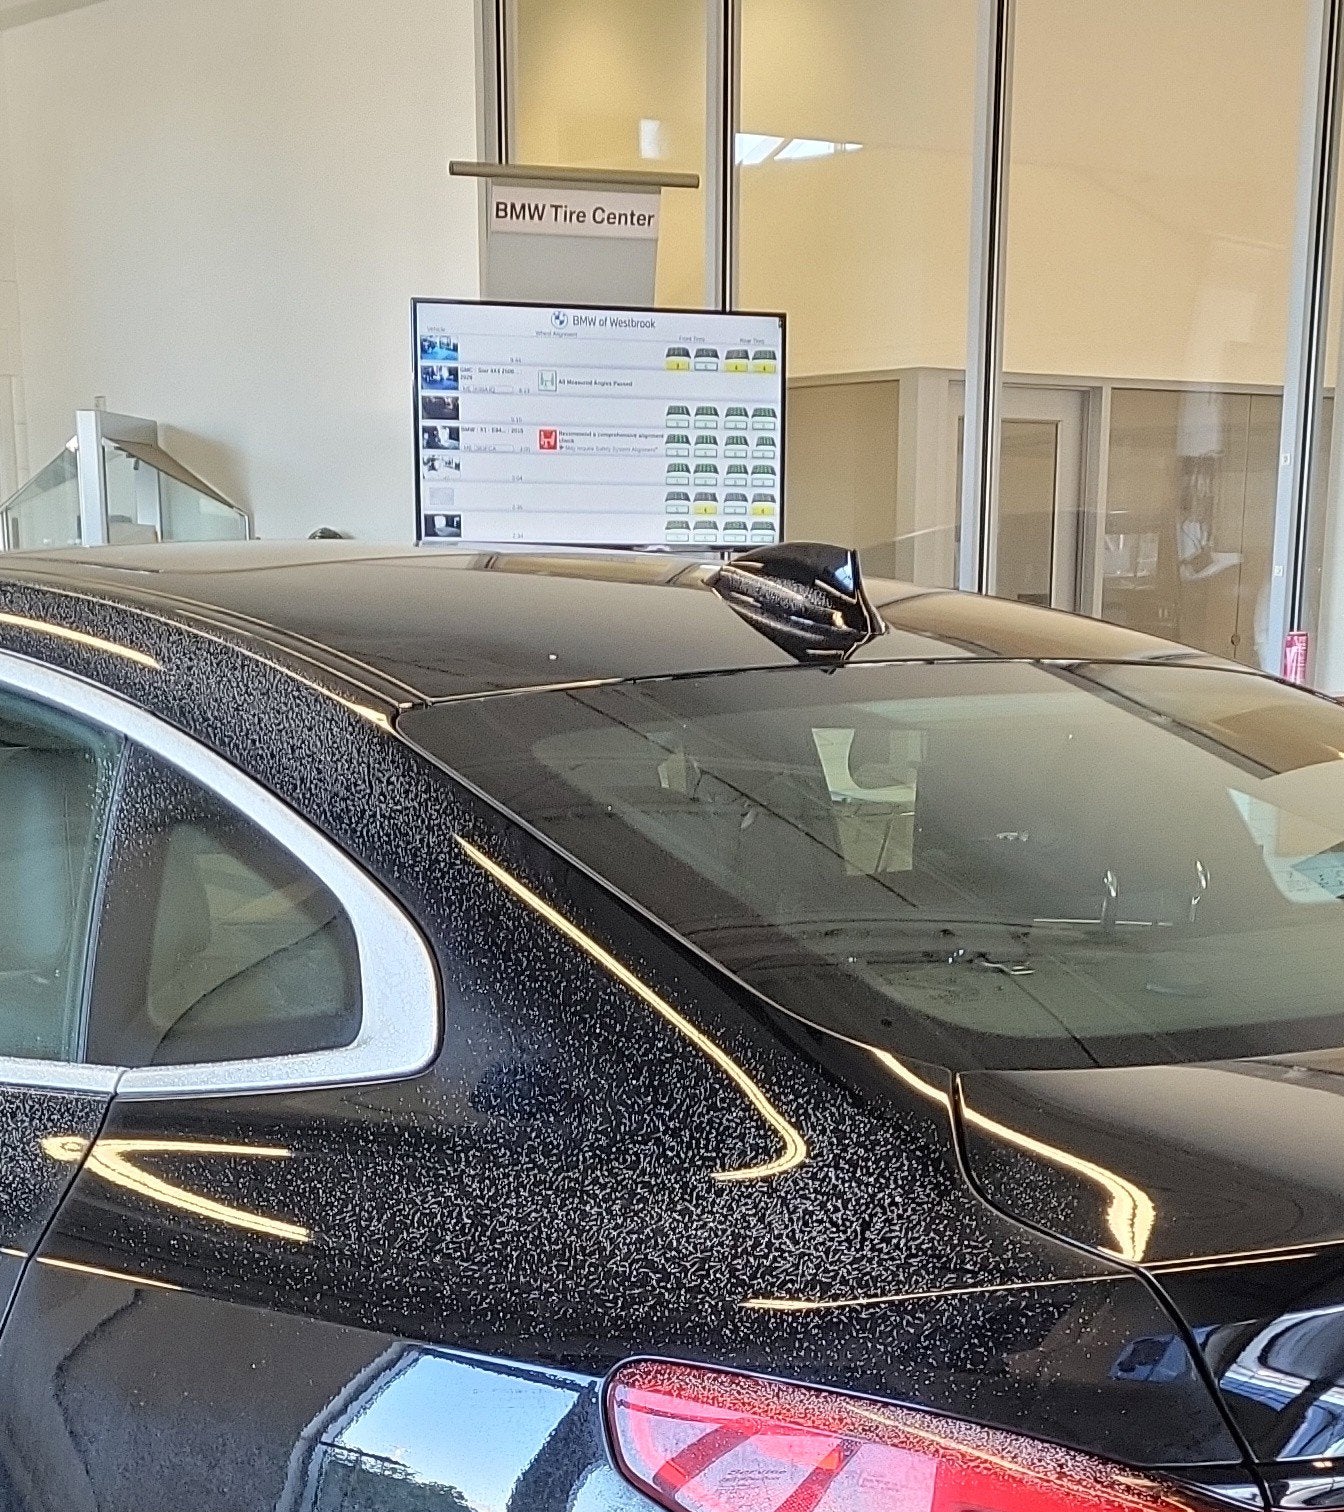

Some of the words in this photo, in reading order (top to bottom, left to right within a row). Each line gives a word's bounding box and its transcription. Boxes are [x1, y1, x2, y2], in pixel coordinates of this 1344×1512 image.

[495, 201, 545, 221] BMW
[550, 204, 586, 223] Tire
[592, 206, 655, 227] Center
[573, 315, 596, 327] BMW
[598, 317, 608, 327] of
[609, 317, 656, 329] Westbrook
